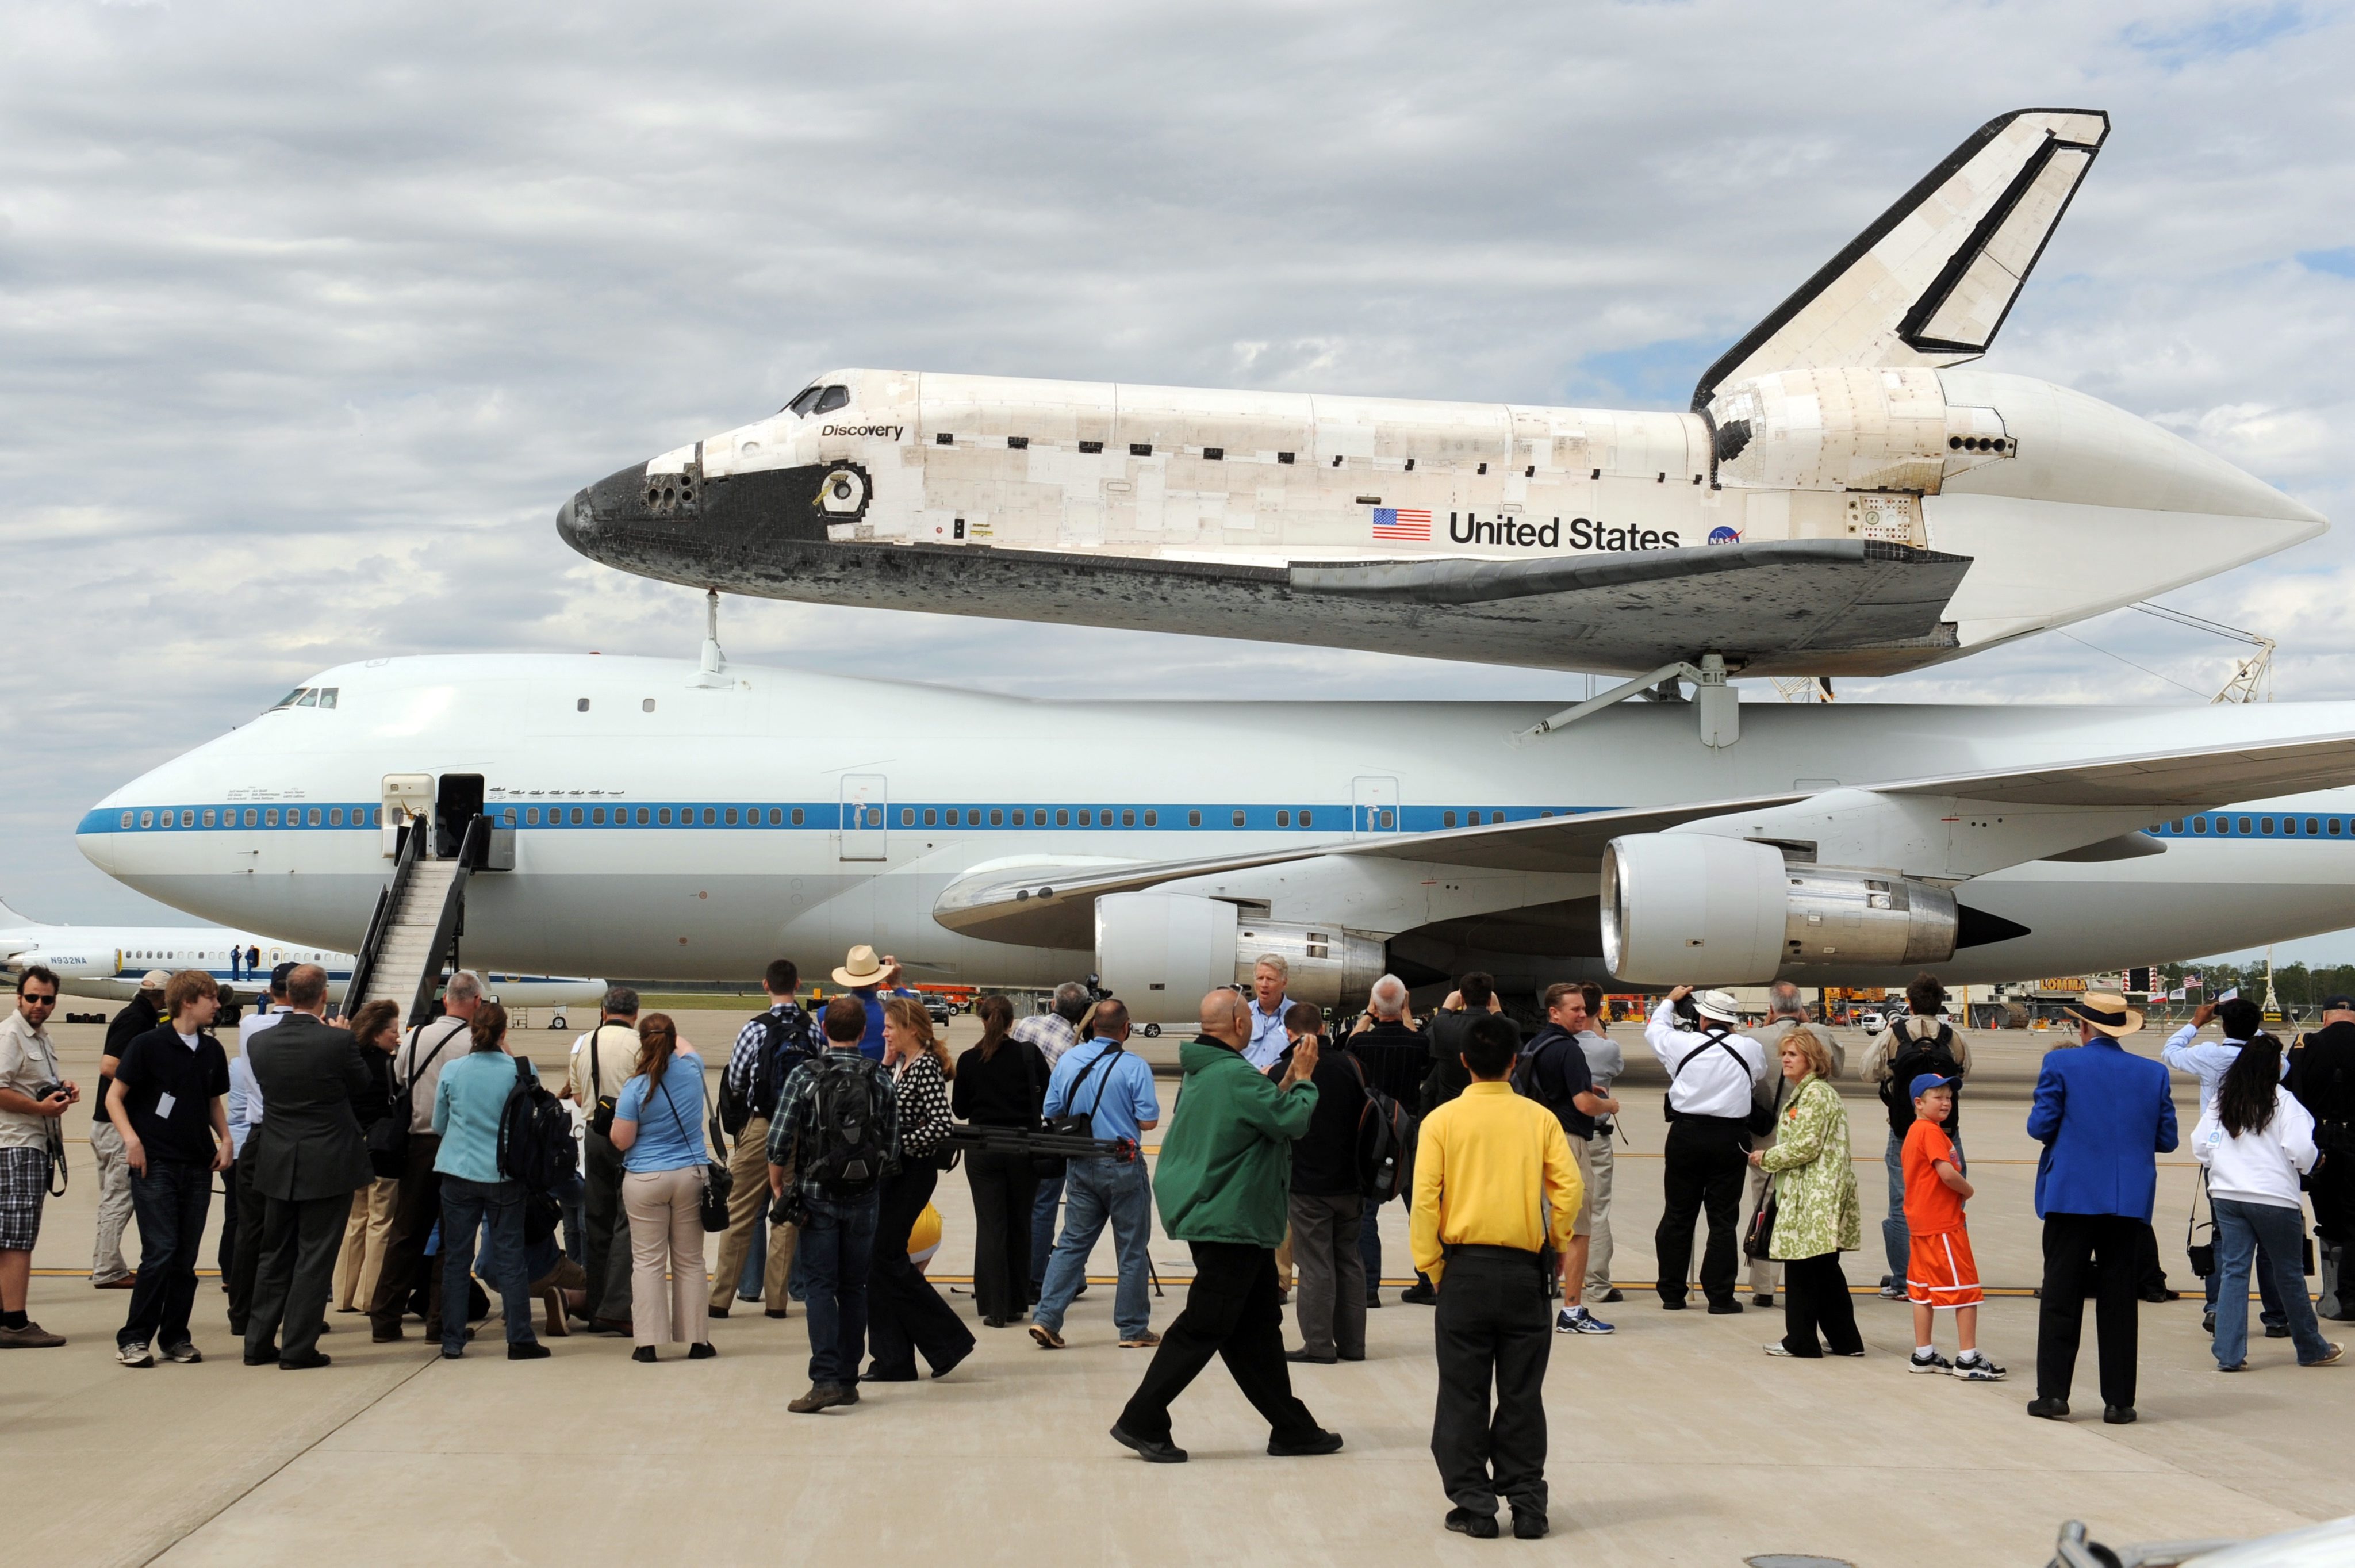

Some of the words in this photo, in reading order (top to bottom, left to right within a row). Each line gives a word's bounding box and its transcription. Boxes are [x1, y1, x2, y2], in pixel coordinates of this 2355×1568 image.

[822, 424, 903, 441] Discovery
[1449, 512, 1559, 547] United
[1569, 517, 1680, 551] States
[1710, 537, 1737, 545] NASA
[51, 956, 87, 964] N932NA
[2040, 978, 2088, 991] LOMMA
